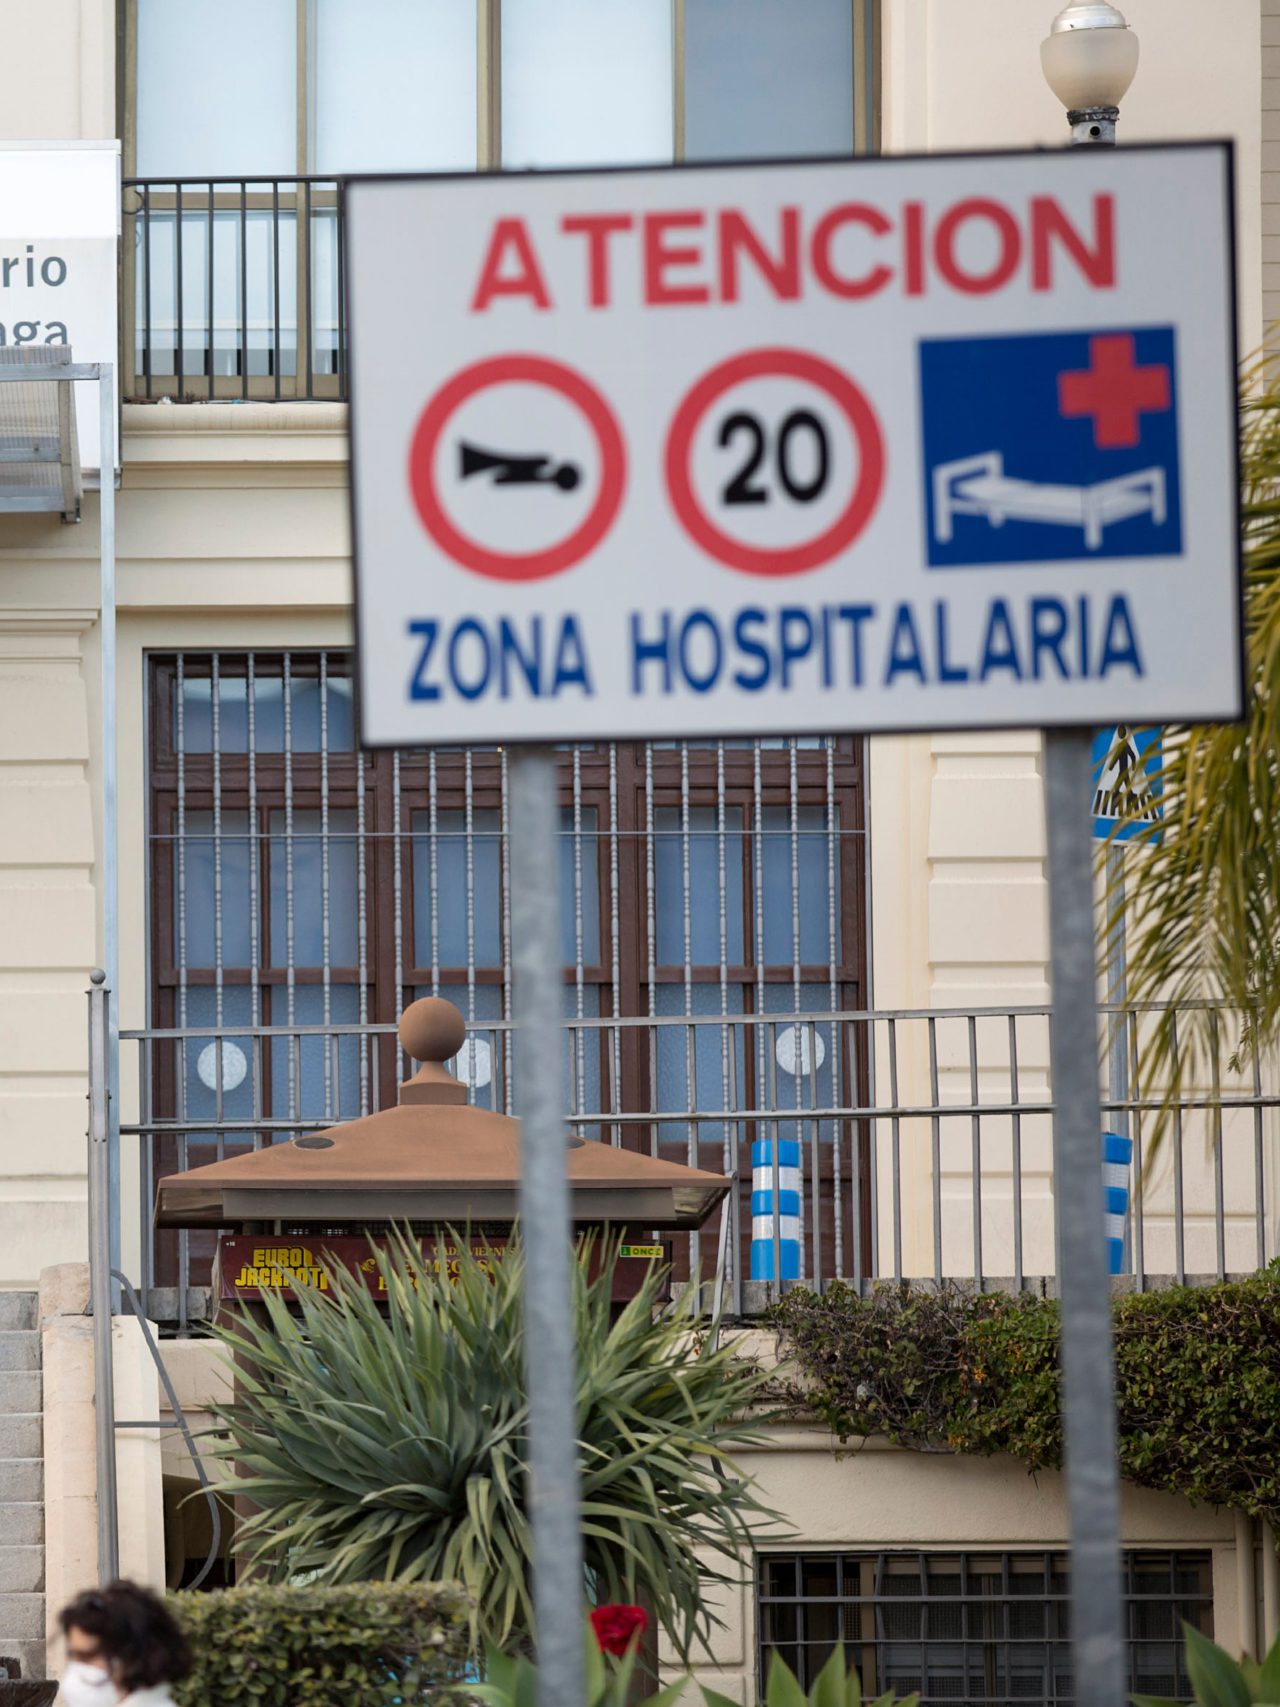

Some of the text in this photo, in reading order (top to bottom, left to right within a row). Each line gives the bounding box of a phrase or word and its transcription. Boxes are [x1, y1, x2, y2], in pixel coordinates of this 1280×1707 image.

[471, 194, 1116, 312] ATENCION
[718, 409, 831, 505] 20
[406, 592, 1146, 704] ZONA HOSPITALARIA
[235, 1267, 321, 1287] JACKPOT
[253, 1248, 302, 1267] EURO
